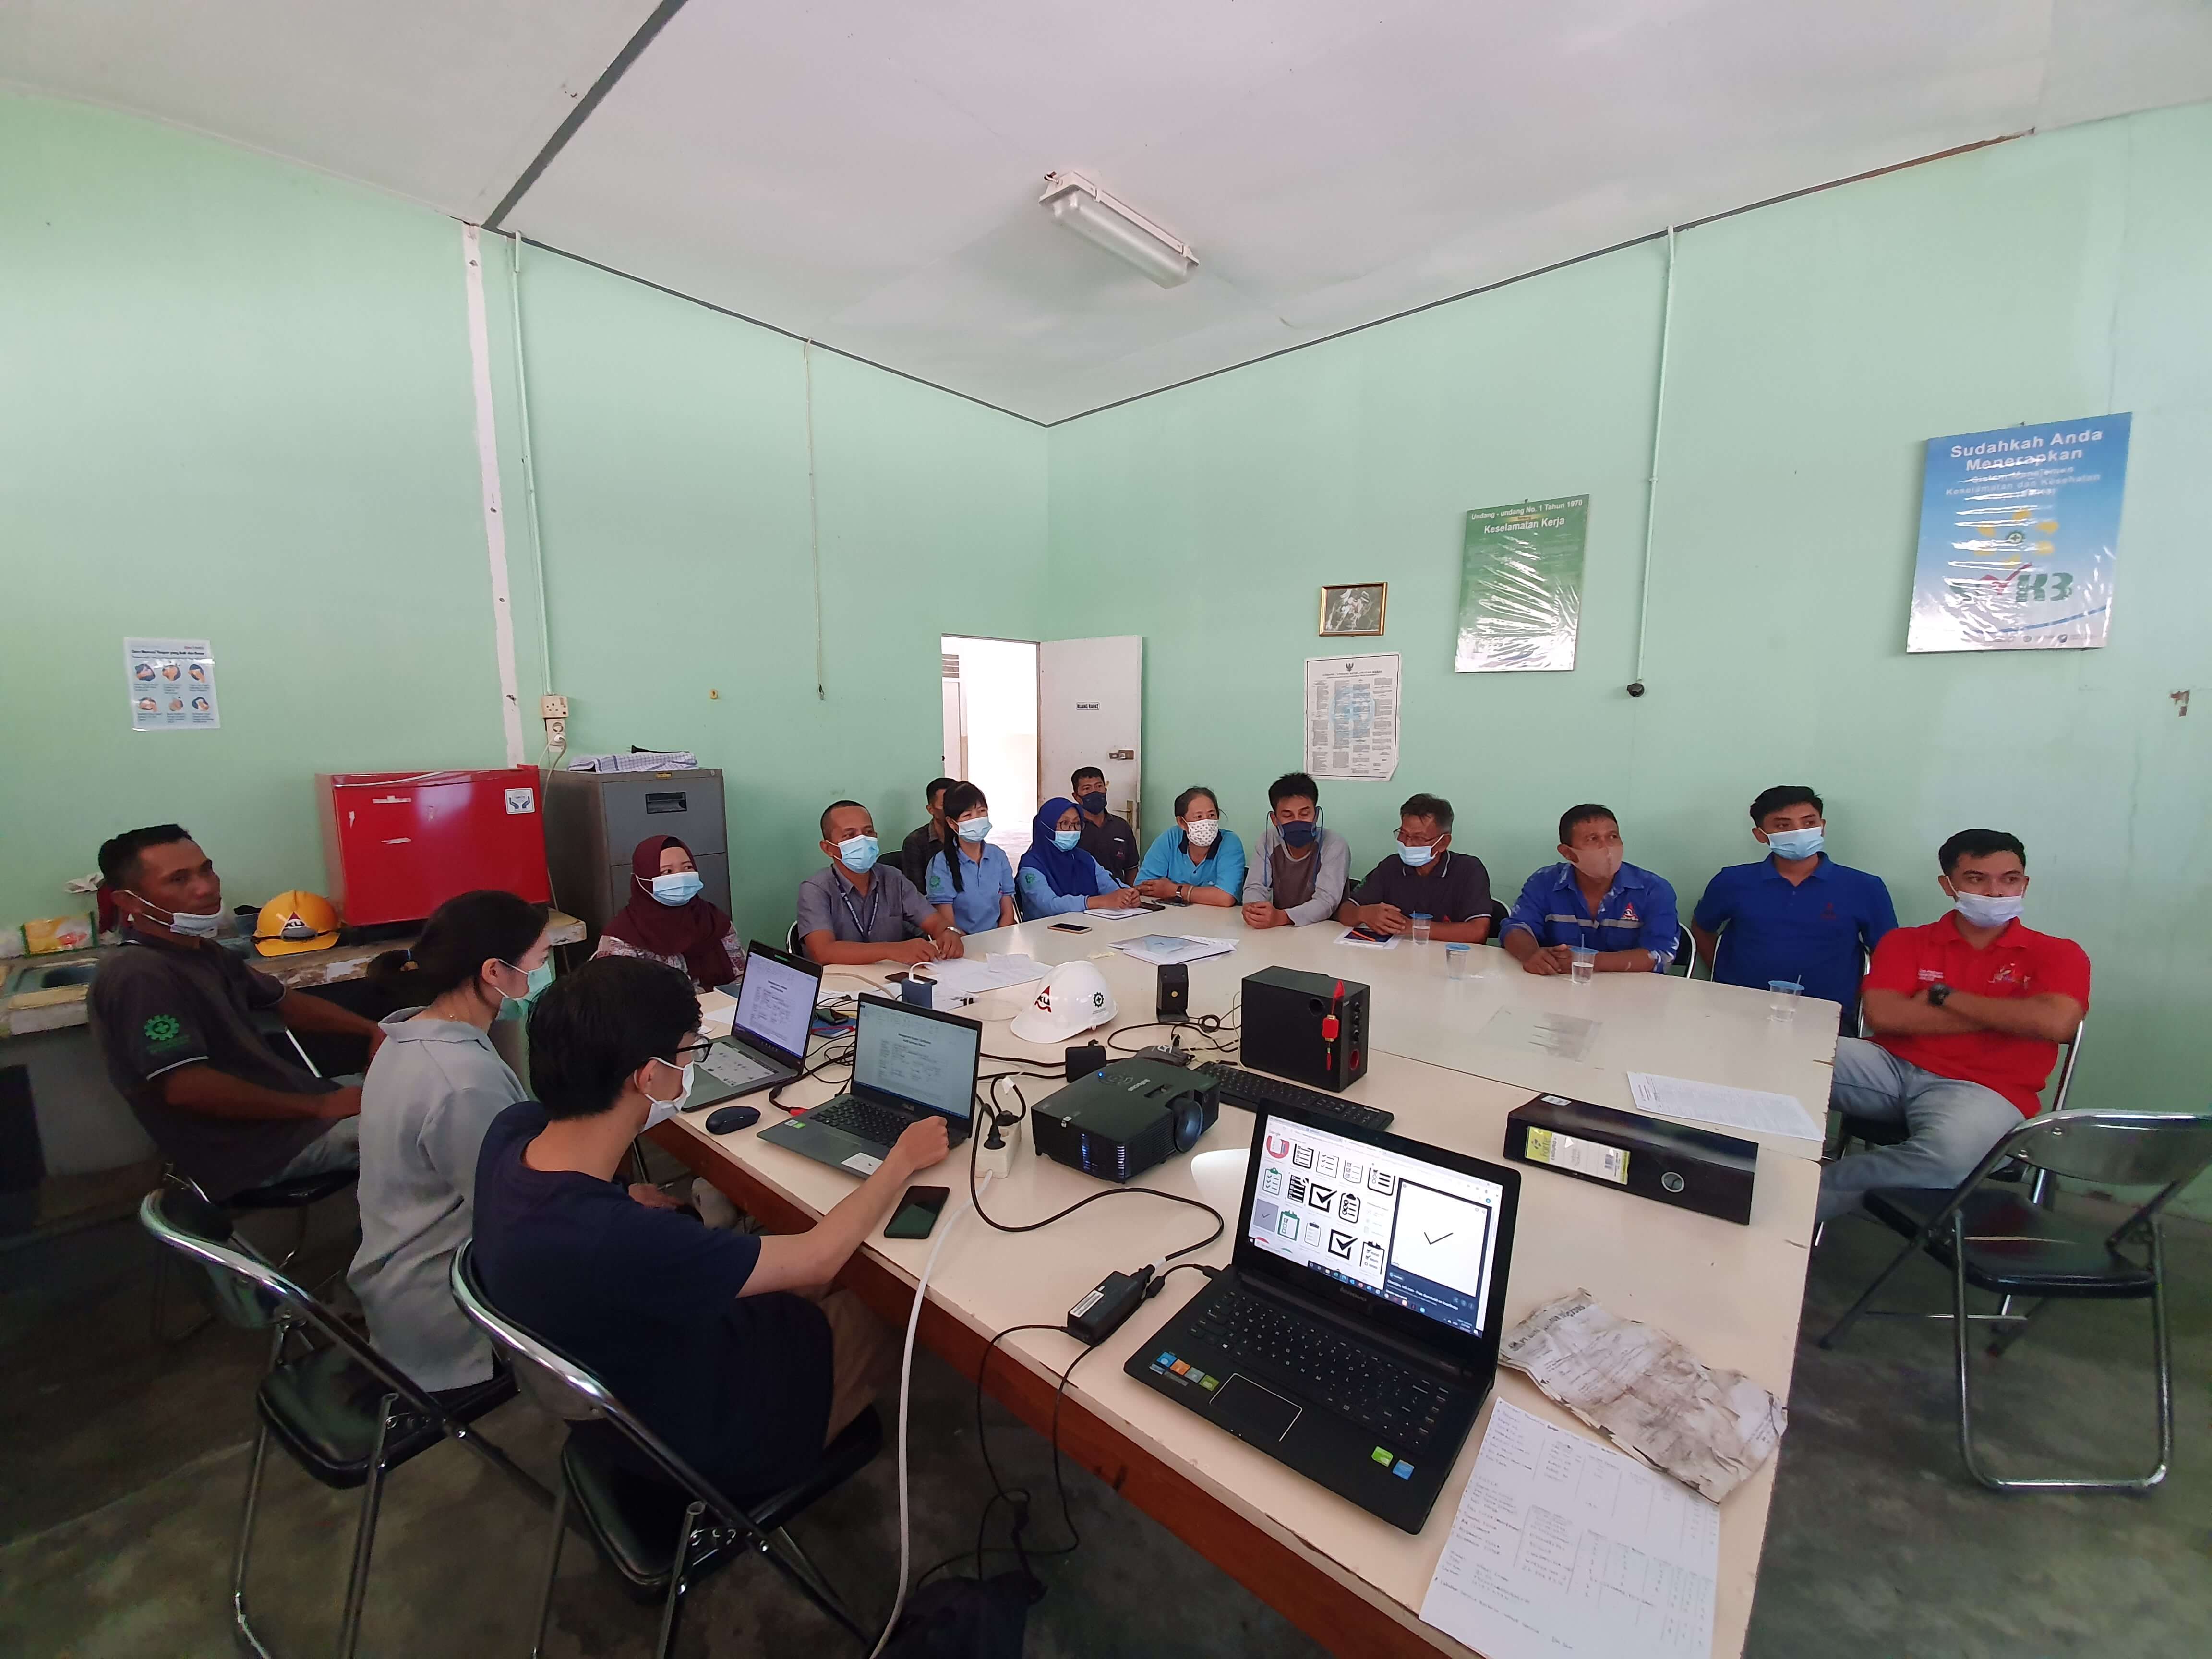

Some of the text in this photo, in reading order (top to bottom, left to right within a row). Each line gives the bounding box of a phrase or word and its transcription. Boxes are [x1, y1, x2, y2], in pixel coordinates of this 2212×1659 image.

[1950, 430, 2104, 457] Sudahkah Anda
[1966, 449, 2083, 471] Menerapkan
[2042, 474, 2101, 485] Kesehatan
[1501, 508, 1525, 517] undang
[1544, 503, 1565, 511] Tahun
[1567, 499, 1583, 507] 1970
[1484, 517, 1565, 534] Keselamatan Kerja
